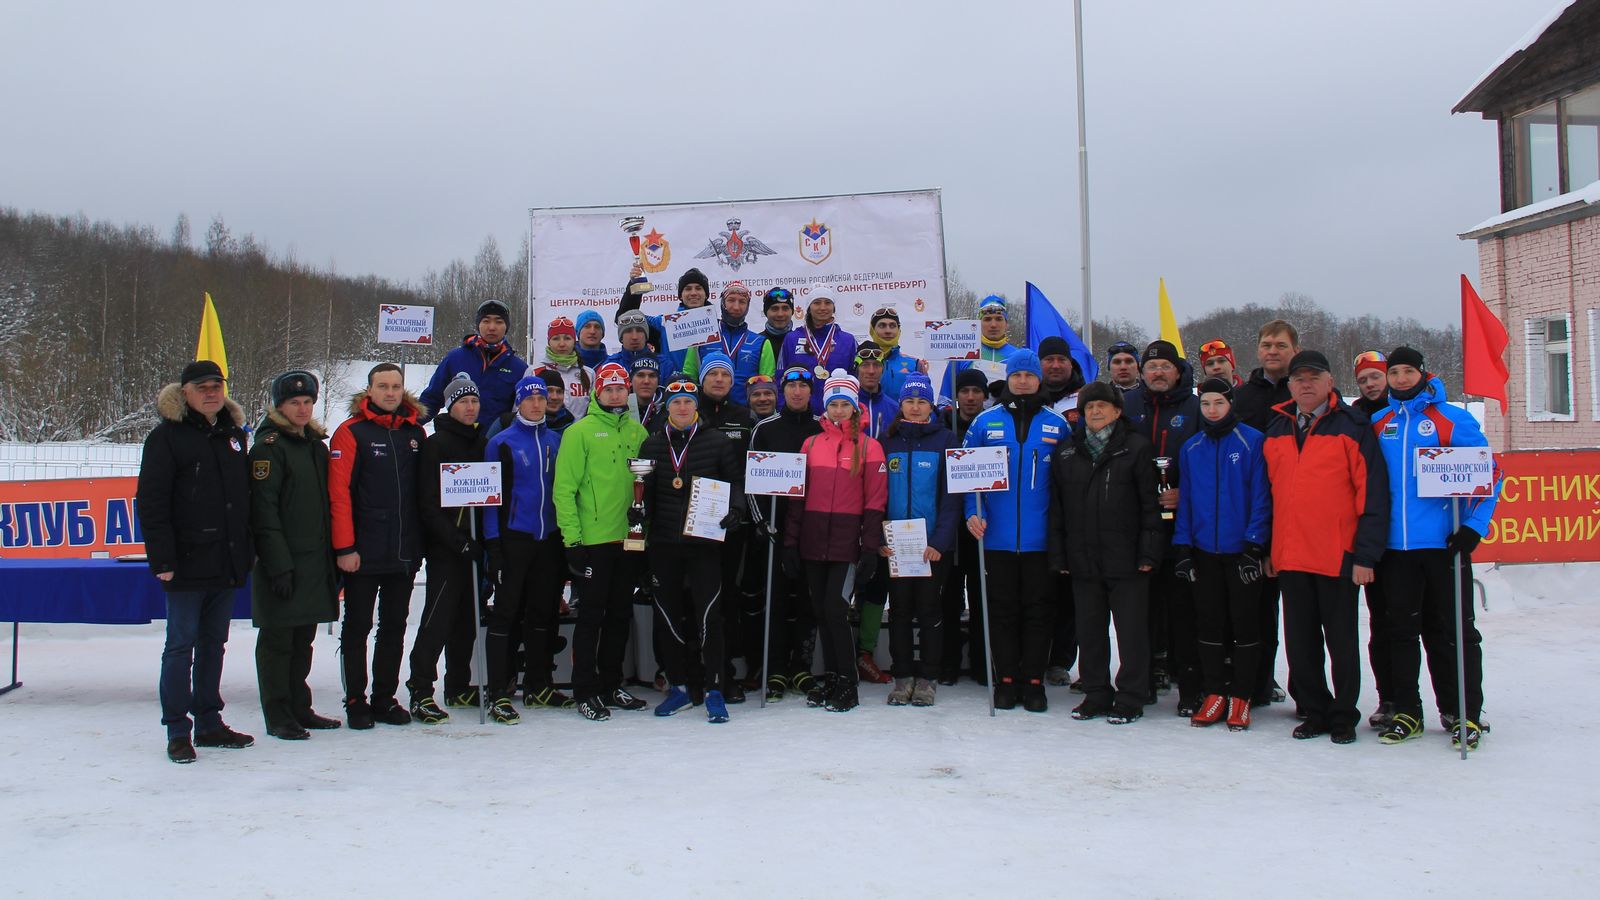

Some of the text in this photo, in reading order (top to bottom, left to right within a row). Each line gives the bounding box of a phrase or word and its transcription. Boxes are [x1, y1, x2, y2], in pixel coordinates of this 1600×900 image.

[582, 287, 626, 297] ФЕДЕРАЛЬНО
[775, 276, 807, 286] ОБОРОНЫ
[854, 271, 894, 281] ФЕДЕРАЦИИ
[550, 296, 620, 307] ЦЕНТРАЛЬНЫЙ
[837, 279, 927, 293] САНКТ-ПЕТЕРБУРГ)
[387, 317, 427, 327] ВОСТОЧНЫЙ
[674, 317, 711, 331] ЗАПАДНЫЙ
[385, 324, 410, 333] ВОЕННЫЙ
[673, 325, 715, 339] ВОЕННЫЙ ОКРУГ
[931, 332, 976, 342] ЦЕНТРАЛЬНЫЙ
[931, 341, 957, 349] ВОЕННЫЙ
[905, 381, 927, 389] LUKOIL
[951, 462, 1005, 472] ВОЕННЫЙ ИНСТИТУТ
[1421, 461, 1490, 474] ВОЕННО-МОРСКОЙ
[750, 467, 803, 479] СЕВЕРНЫЙ ФЛОТ
[950, 470, 1005, 480] ФИЗИЧЕСКОЙ КУЛЬТУРЫ
[1440, 472, 1472, 483] ФЛОТ
[453, 477, 489, 487] ЮЖНЫЙ
[445, 485, 498, 494] ВОЕННЫЙ ОКРУГ
